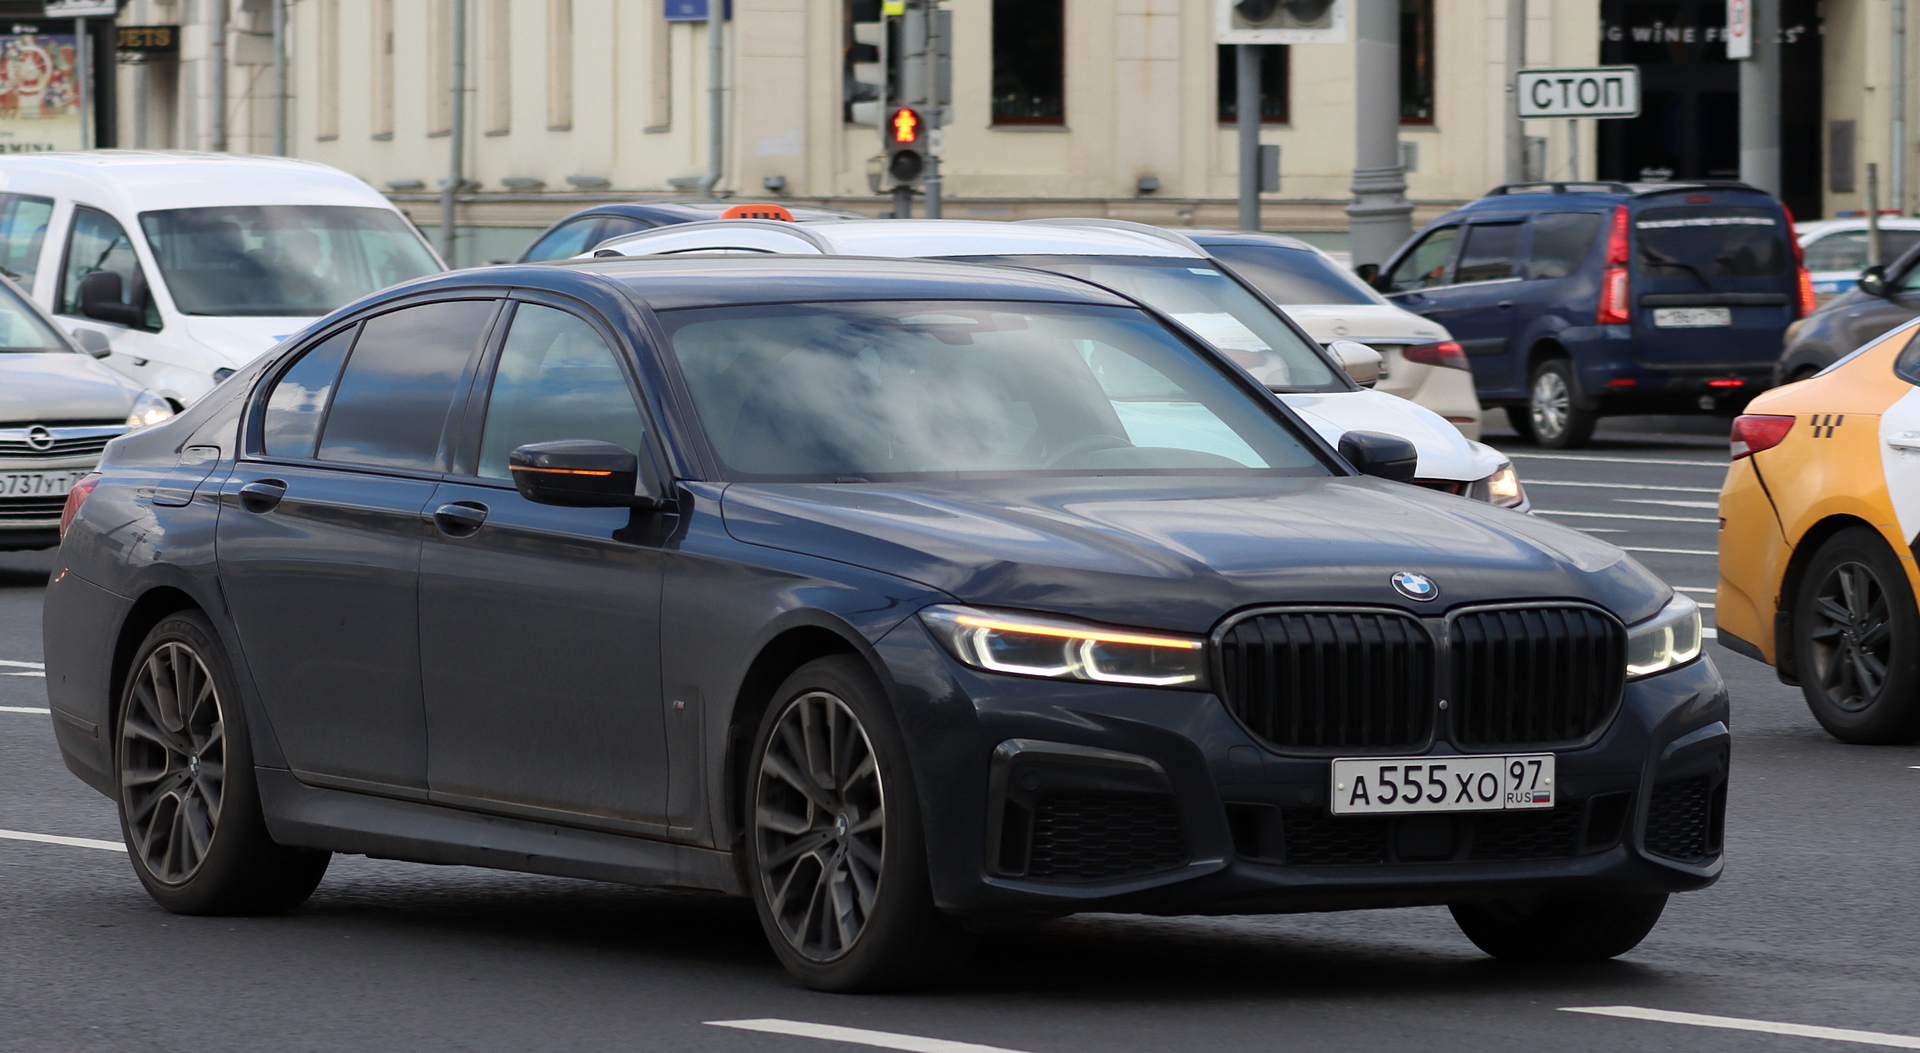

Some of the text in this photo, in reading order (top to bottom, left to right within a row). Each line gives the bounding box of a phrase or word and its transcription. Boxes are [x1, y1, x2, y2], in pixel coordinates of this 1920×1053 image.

[1531, 77, 1622, 109] СТОП
[1509, 759, 1542, 791] 97
[1506, 792, 1532, 804] RUS
